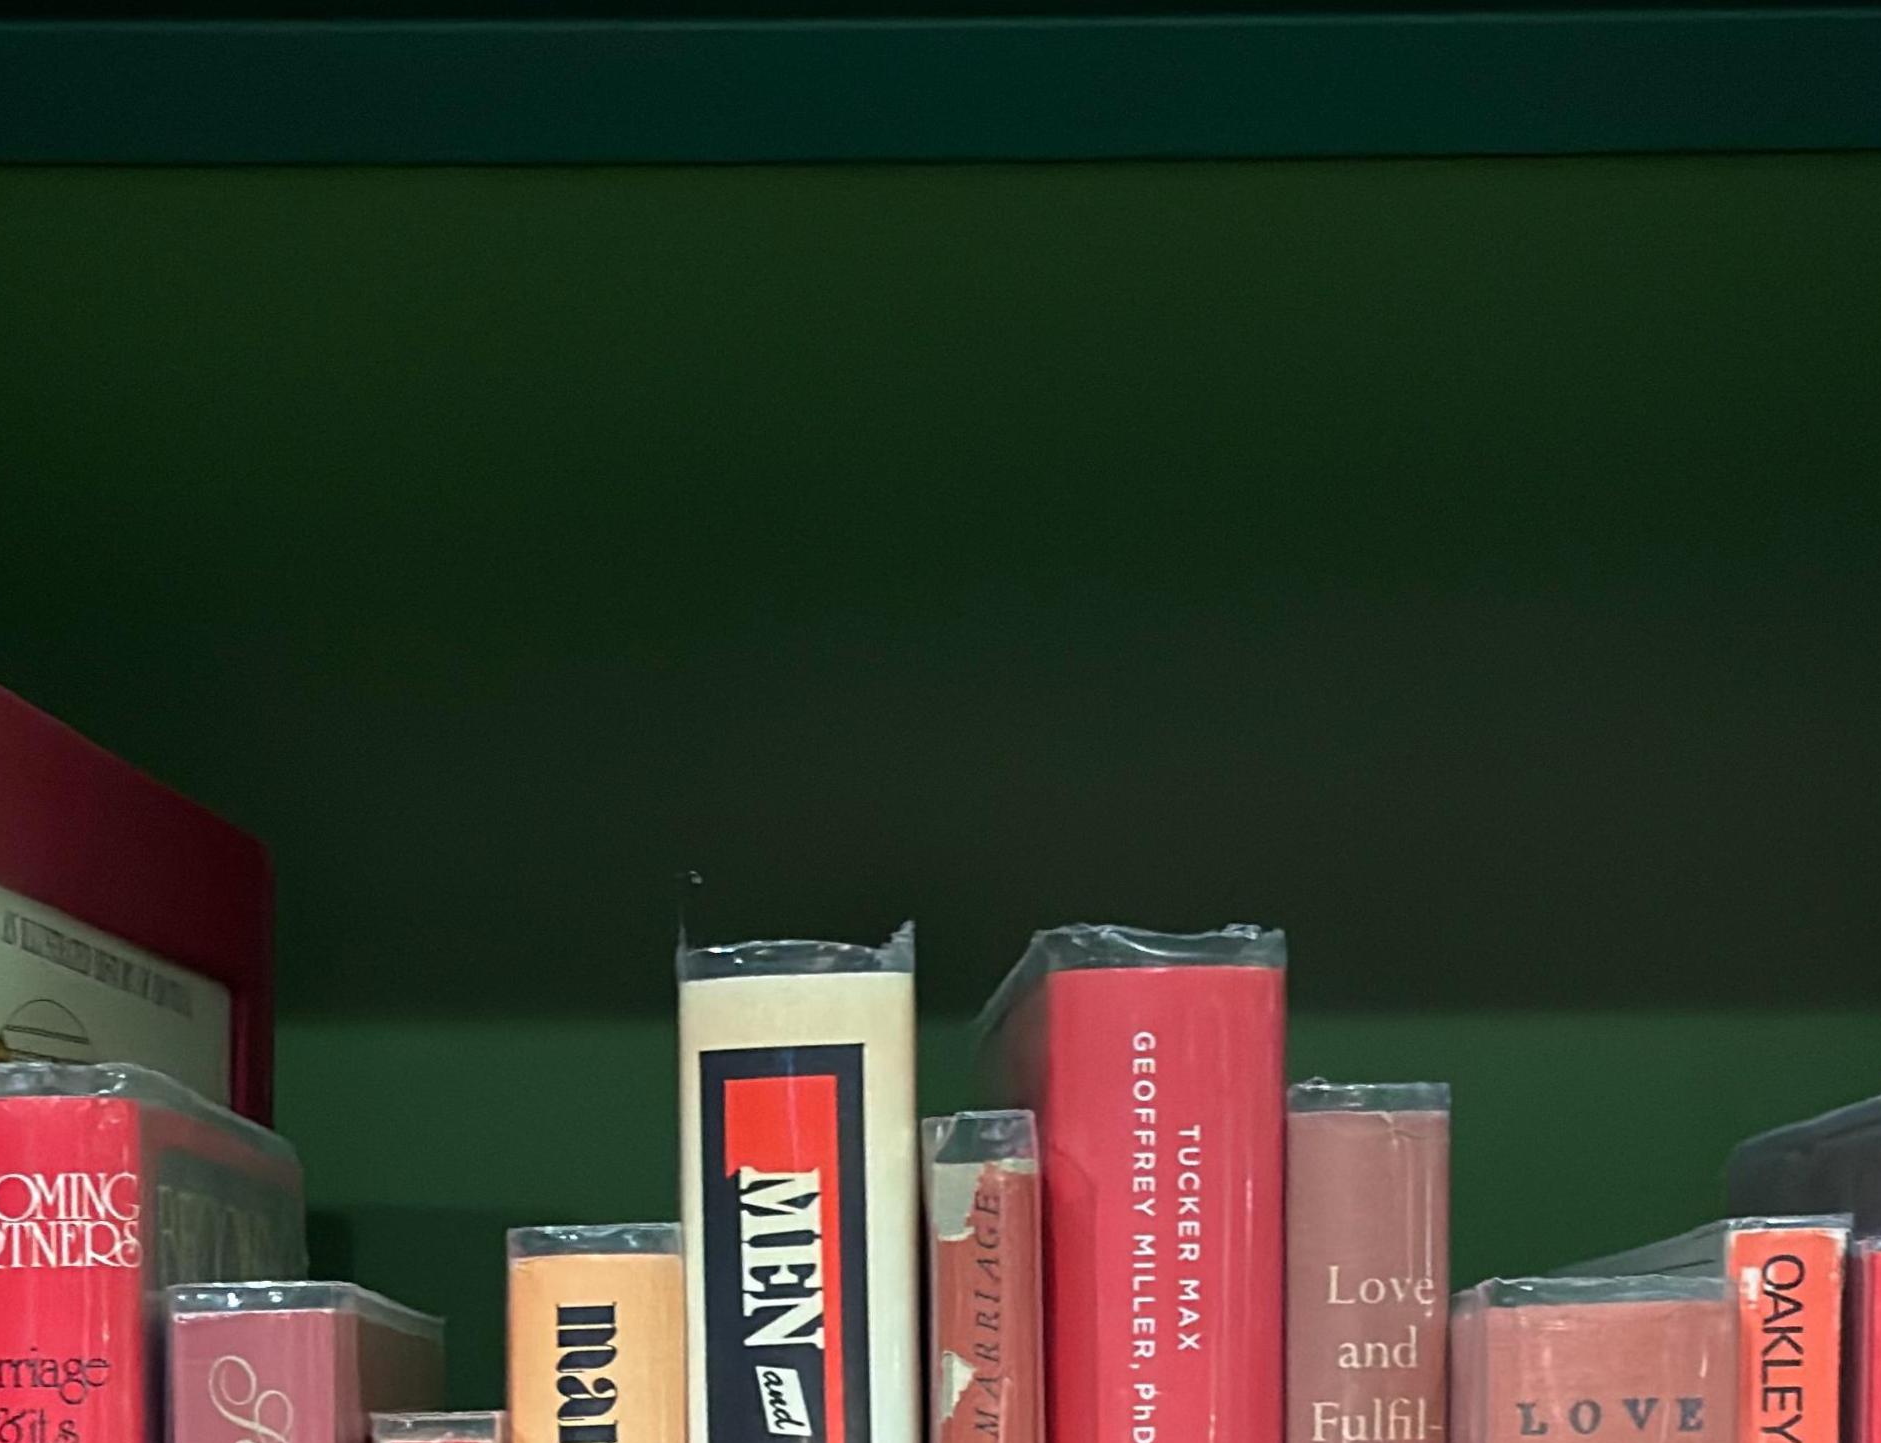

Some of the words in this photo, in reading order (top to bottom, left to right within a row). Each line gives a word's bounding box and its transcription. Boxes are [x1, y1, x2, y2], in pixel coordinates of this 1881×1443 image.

[1133, 1031, 1156, 1217] GEOFFREY
[1178, 1124, 1200, 1263] TUCKER
[739, 1166, 825, 1349] MEN
[1132, 1235, 1156, 1370] MILLER,
[1178, 1280, 1200, 1351] MAX
[1338, 1328, 1418, 1369] and
[760, 1367, 793, 1430] and
[1517, 1397, 1704, 1435] LOVE
